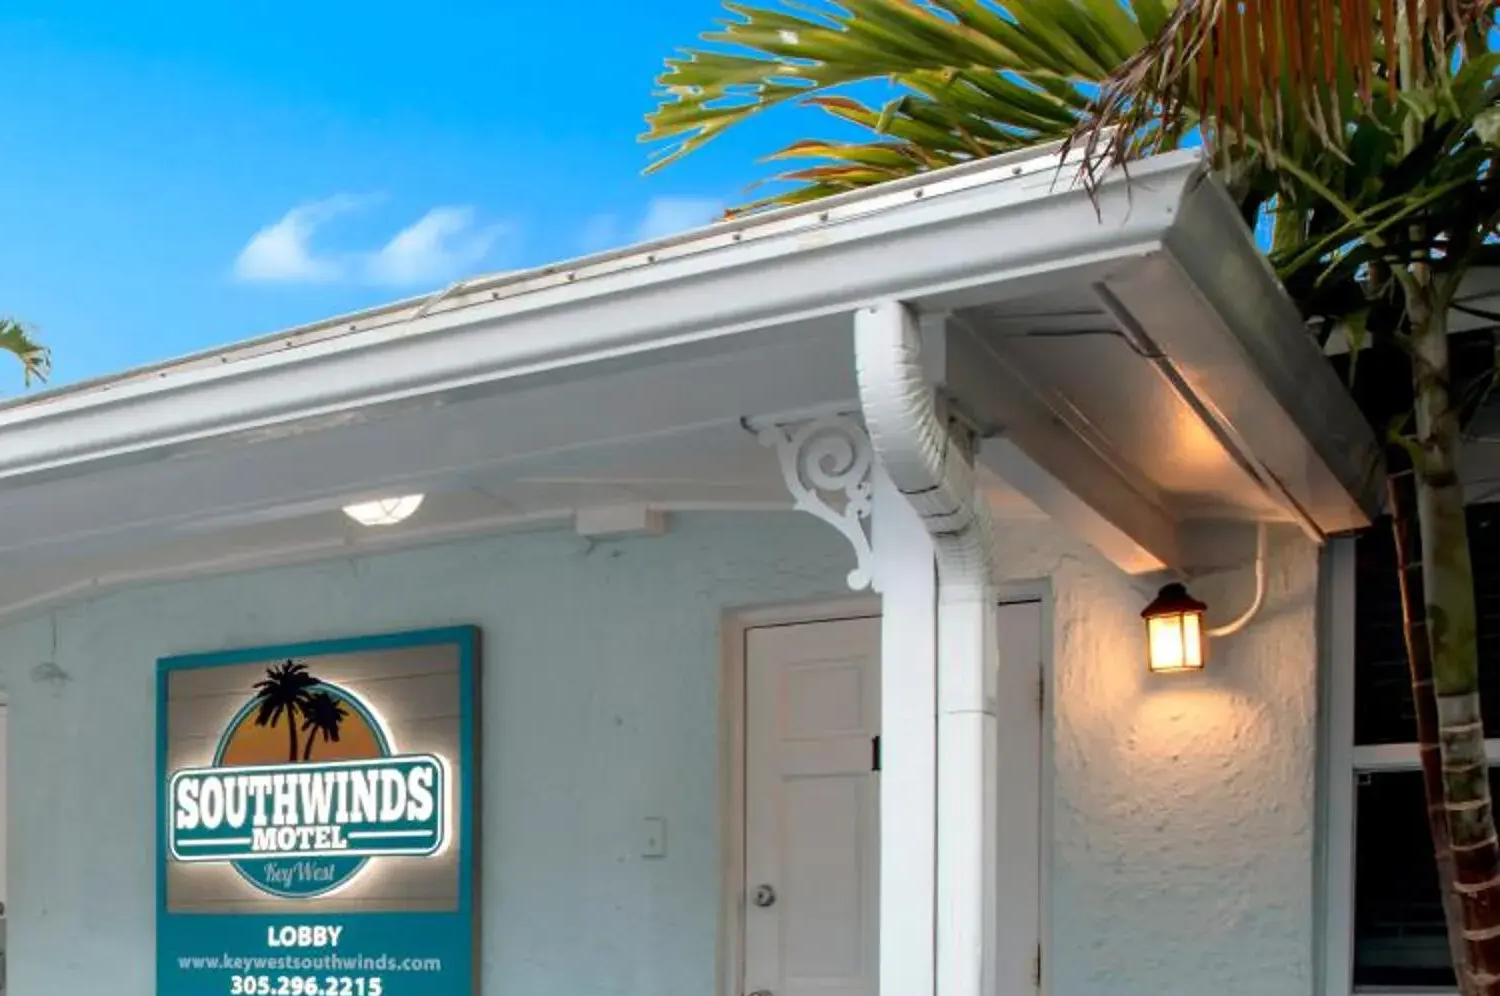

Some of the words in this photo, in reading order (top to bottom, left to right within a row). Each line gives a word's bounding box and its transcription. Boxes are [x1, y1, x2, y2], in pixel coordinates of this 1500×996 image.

[176, 767, 434, 830] SOUTHWINDS
[252, 825, 347, 851] MOTEL
[263, 863, 294, 888] Key
[293, 862, 336, 882] West
[267, 925, 343, 947] LOBBY
[177, 952, 441, 974] www.keywestsouthwinds.com
